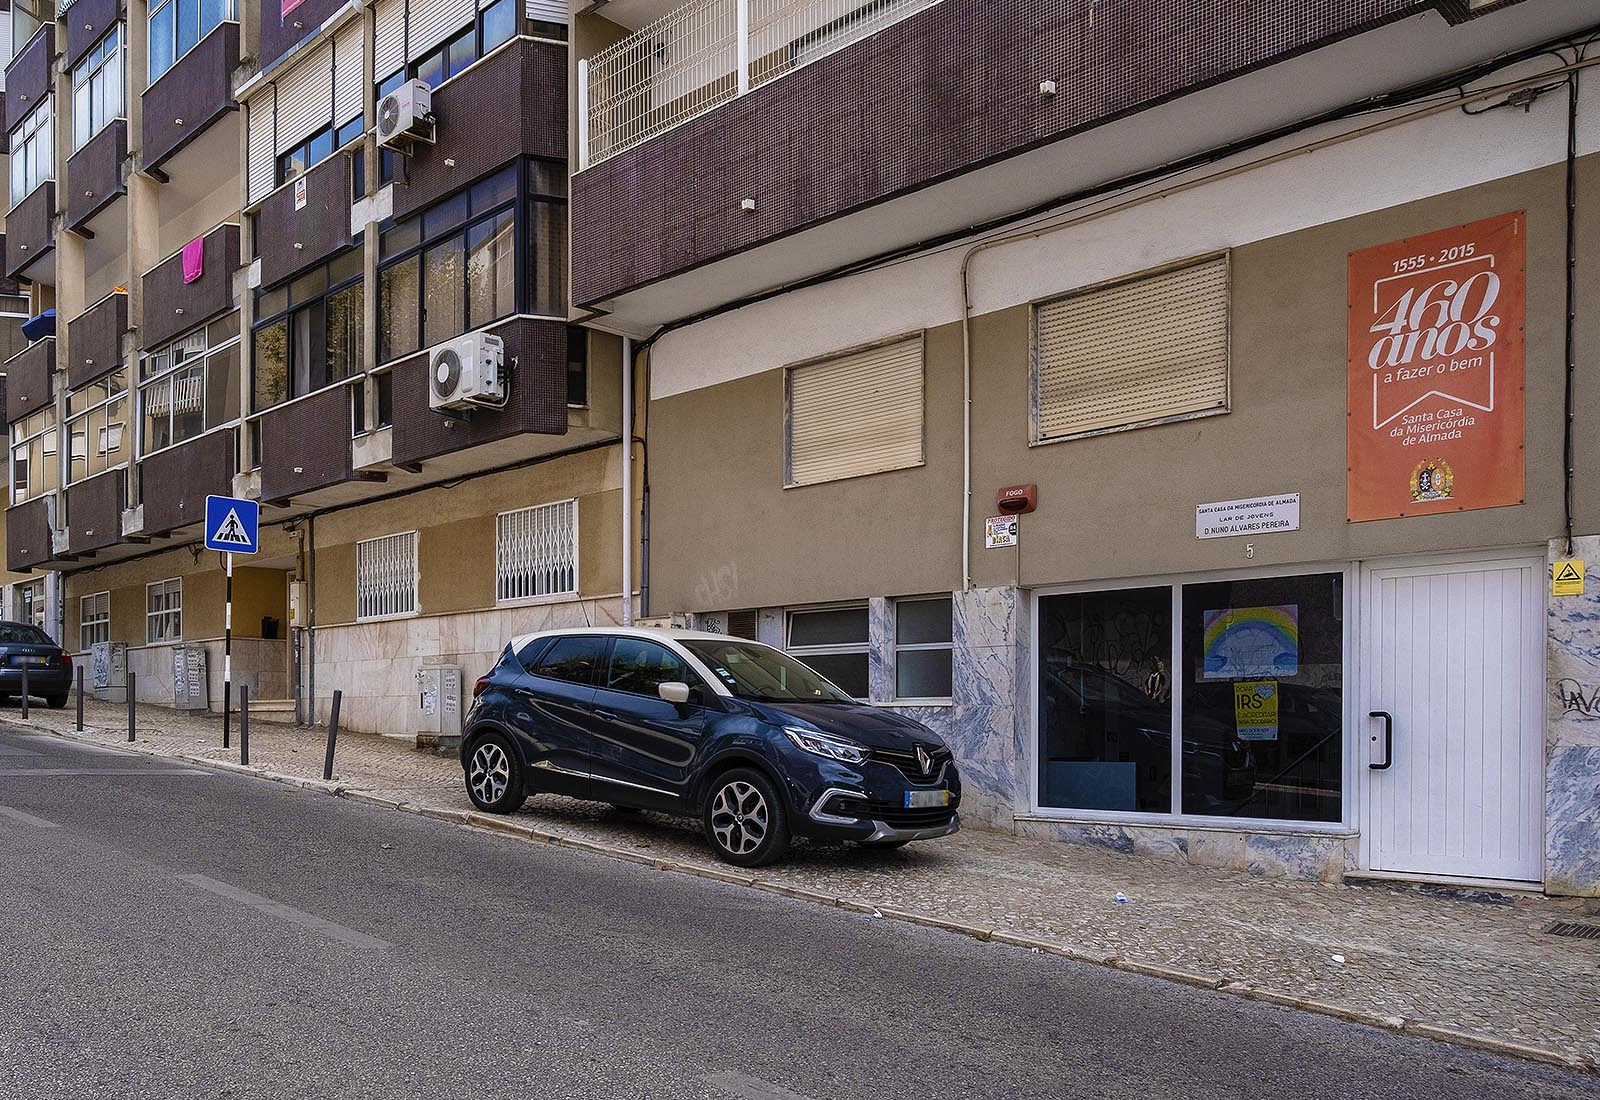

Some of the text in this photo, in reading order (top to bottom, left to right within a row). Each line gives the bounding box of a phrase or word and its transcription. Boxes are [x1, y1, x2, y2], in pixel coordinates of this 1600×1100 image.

[1392, 242, 1475, 273] 1555 2015
[1369, 271, 1501, 335] 460
[1368, 315, 1500, 370] anos
[1384, 355, 1483, 384] a fazer o bem
[1401, 408, 1463, 425] Santa Casa
[1390, 416, 1475, 438] da Misericórdia
[1402, 429, 1462, 447] de Almada
[1005, 489, 1024, 497] FOGO
[1247, 512, 1274, 520] JOVENS
[1261, 520, 1290, 529] PEREIRA
[1246, 543, 1254, 559] 5
[1236, 694, 1263, 709] IRS
